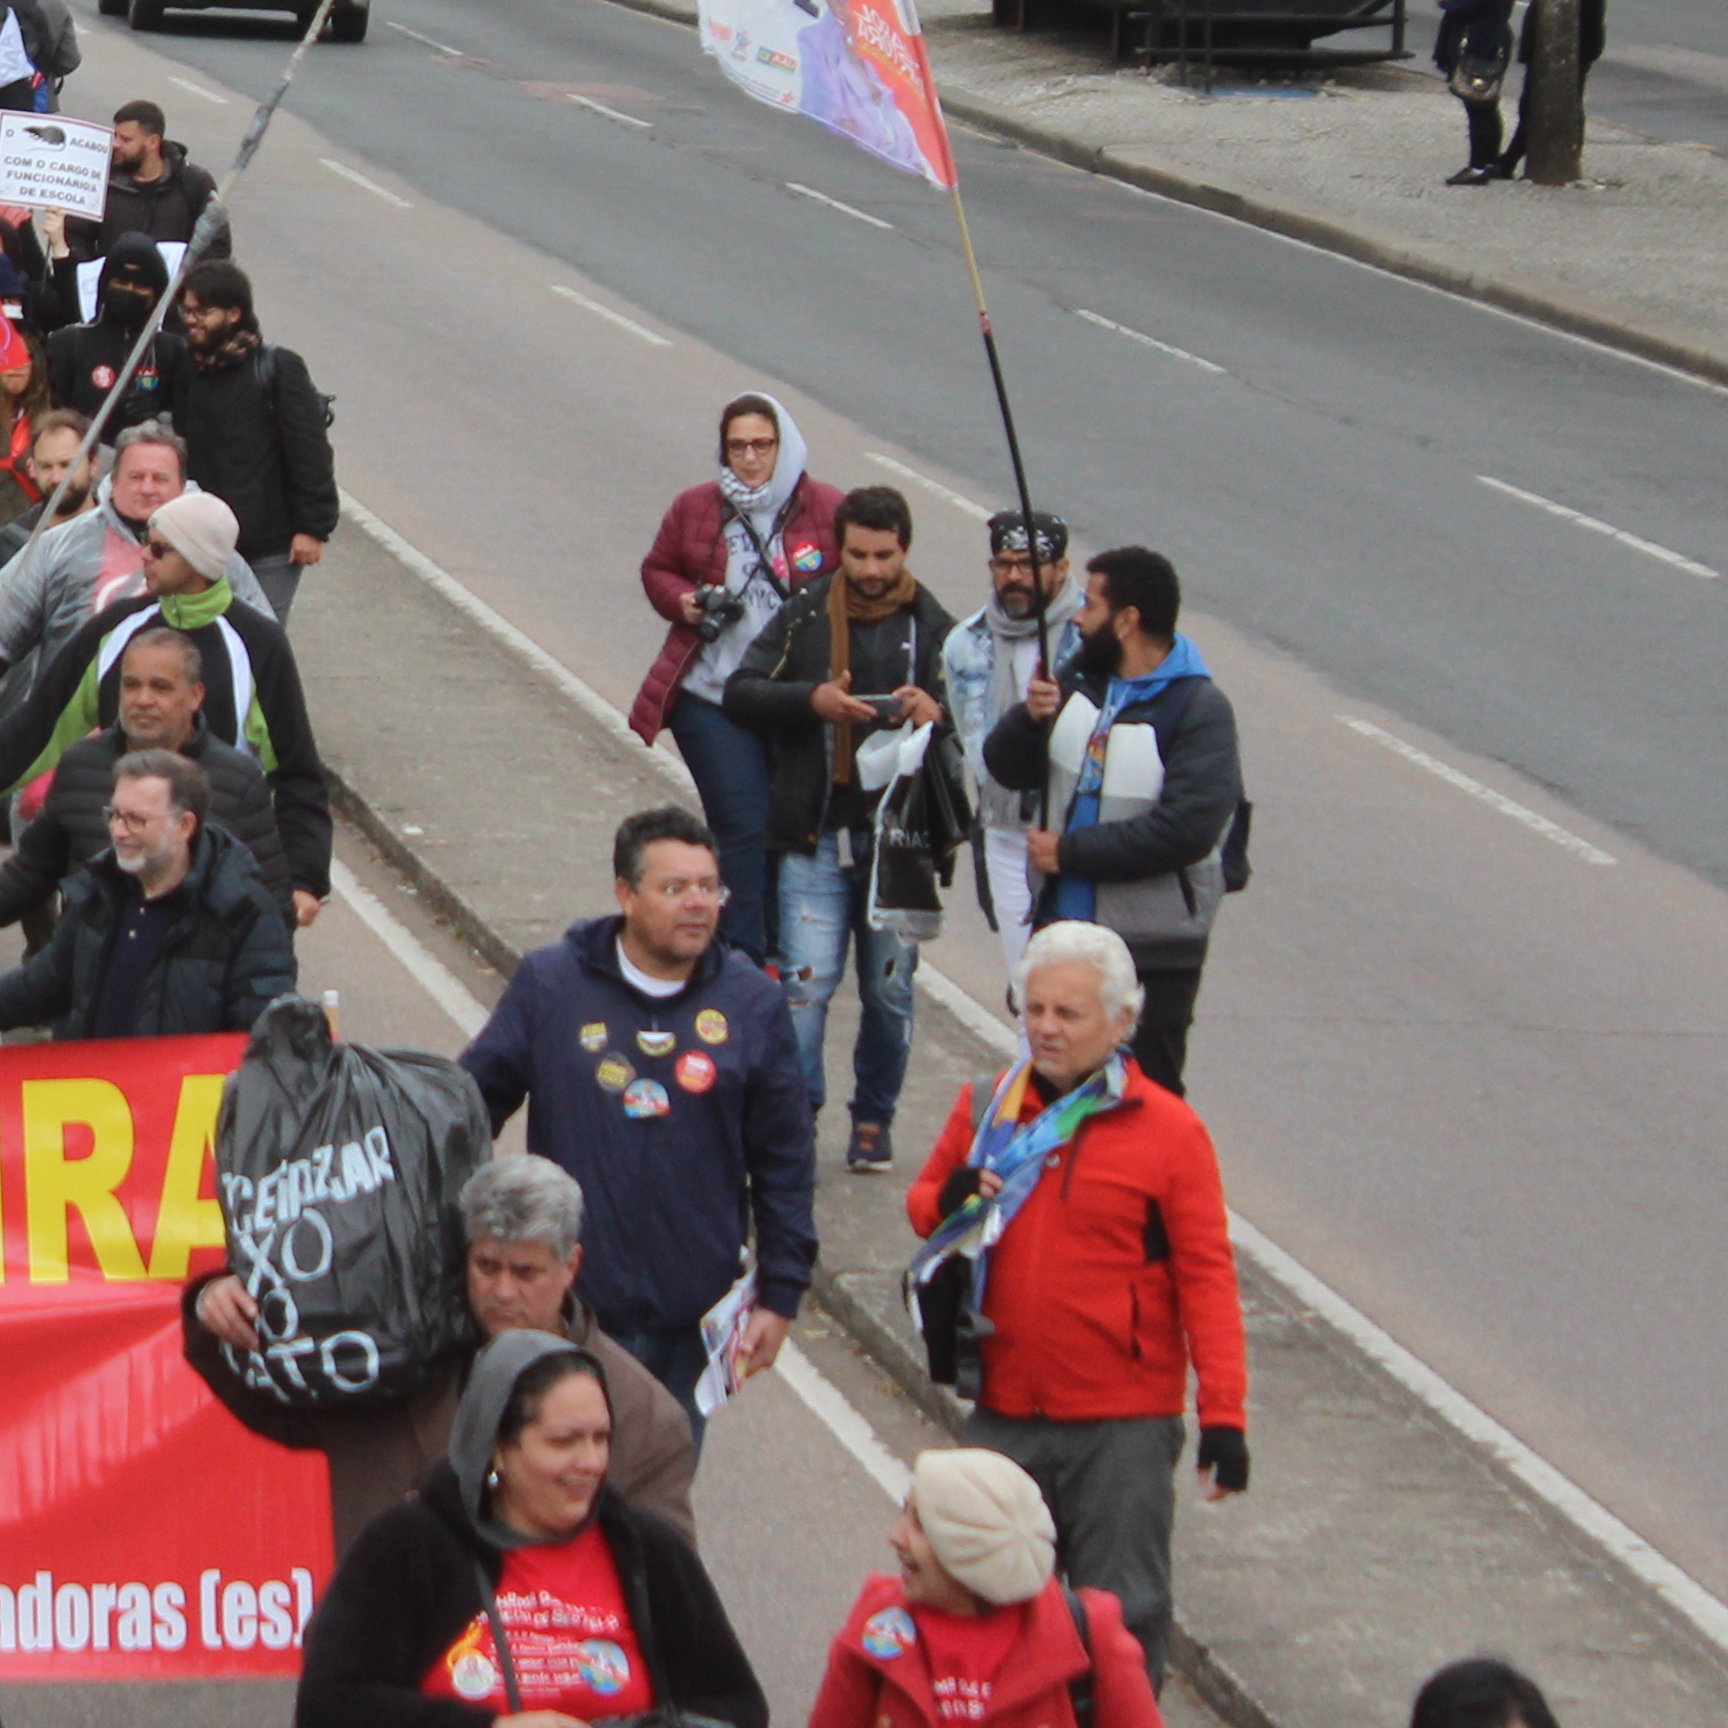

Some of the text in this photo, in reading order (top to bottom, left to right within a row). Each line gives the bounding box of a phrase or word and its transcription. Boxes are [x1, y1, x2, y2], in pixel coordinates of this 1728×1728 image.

[6, 128, 109, 154] O ACABOU
[4, 155, 102, 181] COM O CARGO DE
[19, 185, 86, 205] DE ESCOLA
[199, 1567, 314, 1650] (es)
